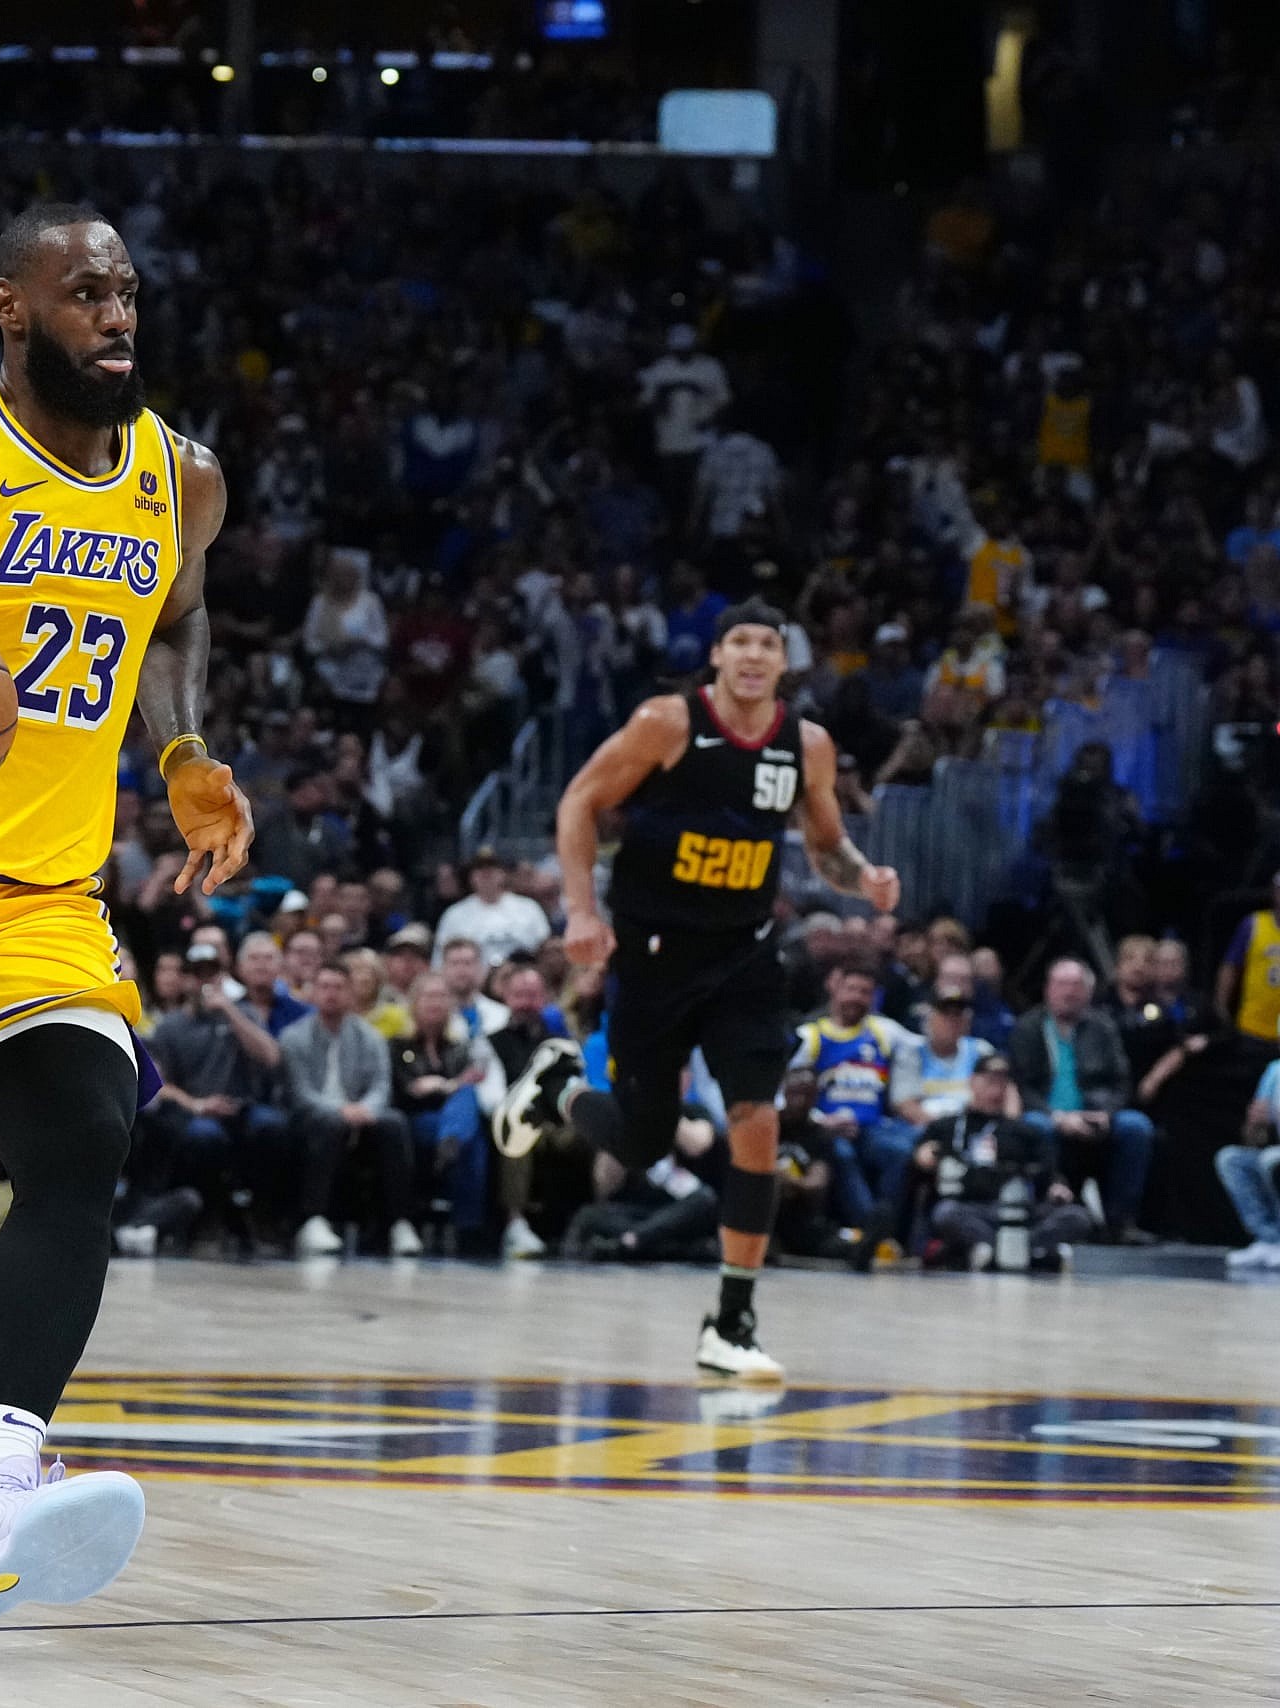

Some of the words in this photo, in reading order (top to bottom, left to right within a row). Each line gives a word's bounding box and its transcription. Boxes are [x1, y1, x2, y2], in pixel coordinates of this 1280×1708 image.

[134, 494, 167, 517] bibigo
[14, 602, 128, 732] 23
[752, 762, 798, 812] 50
[673, 831, 774, 890] 5280
